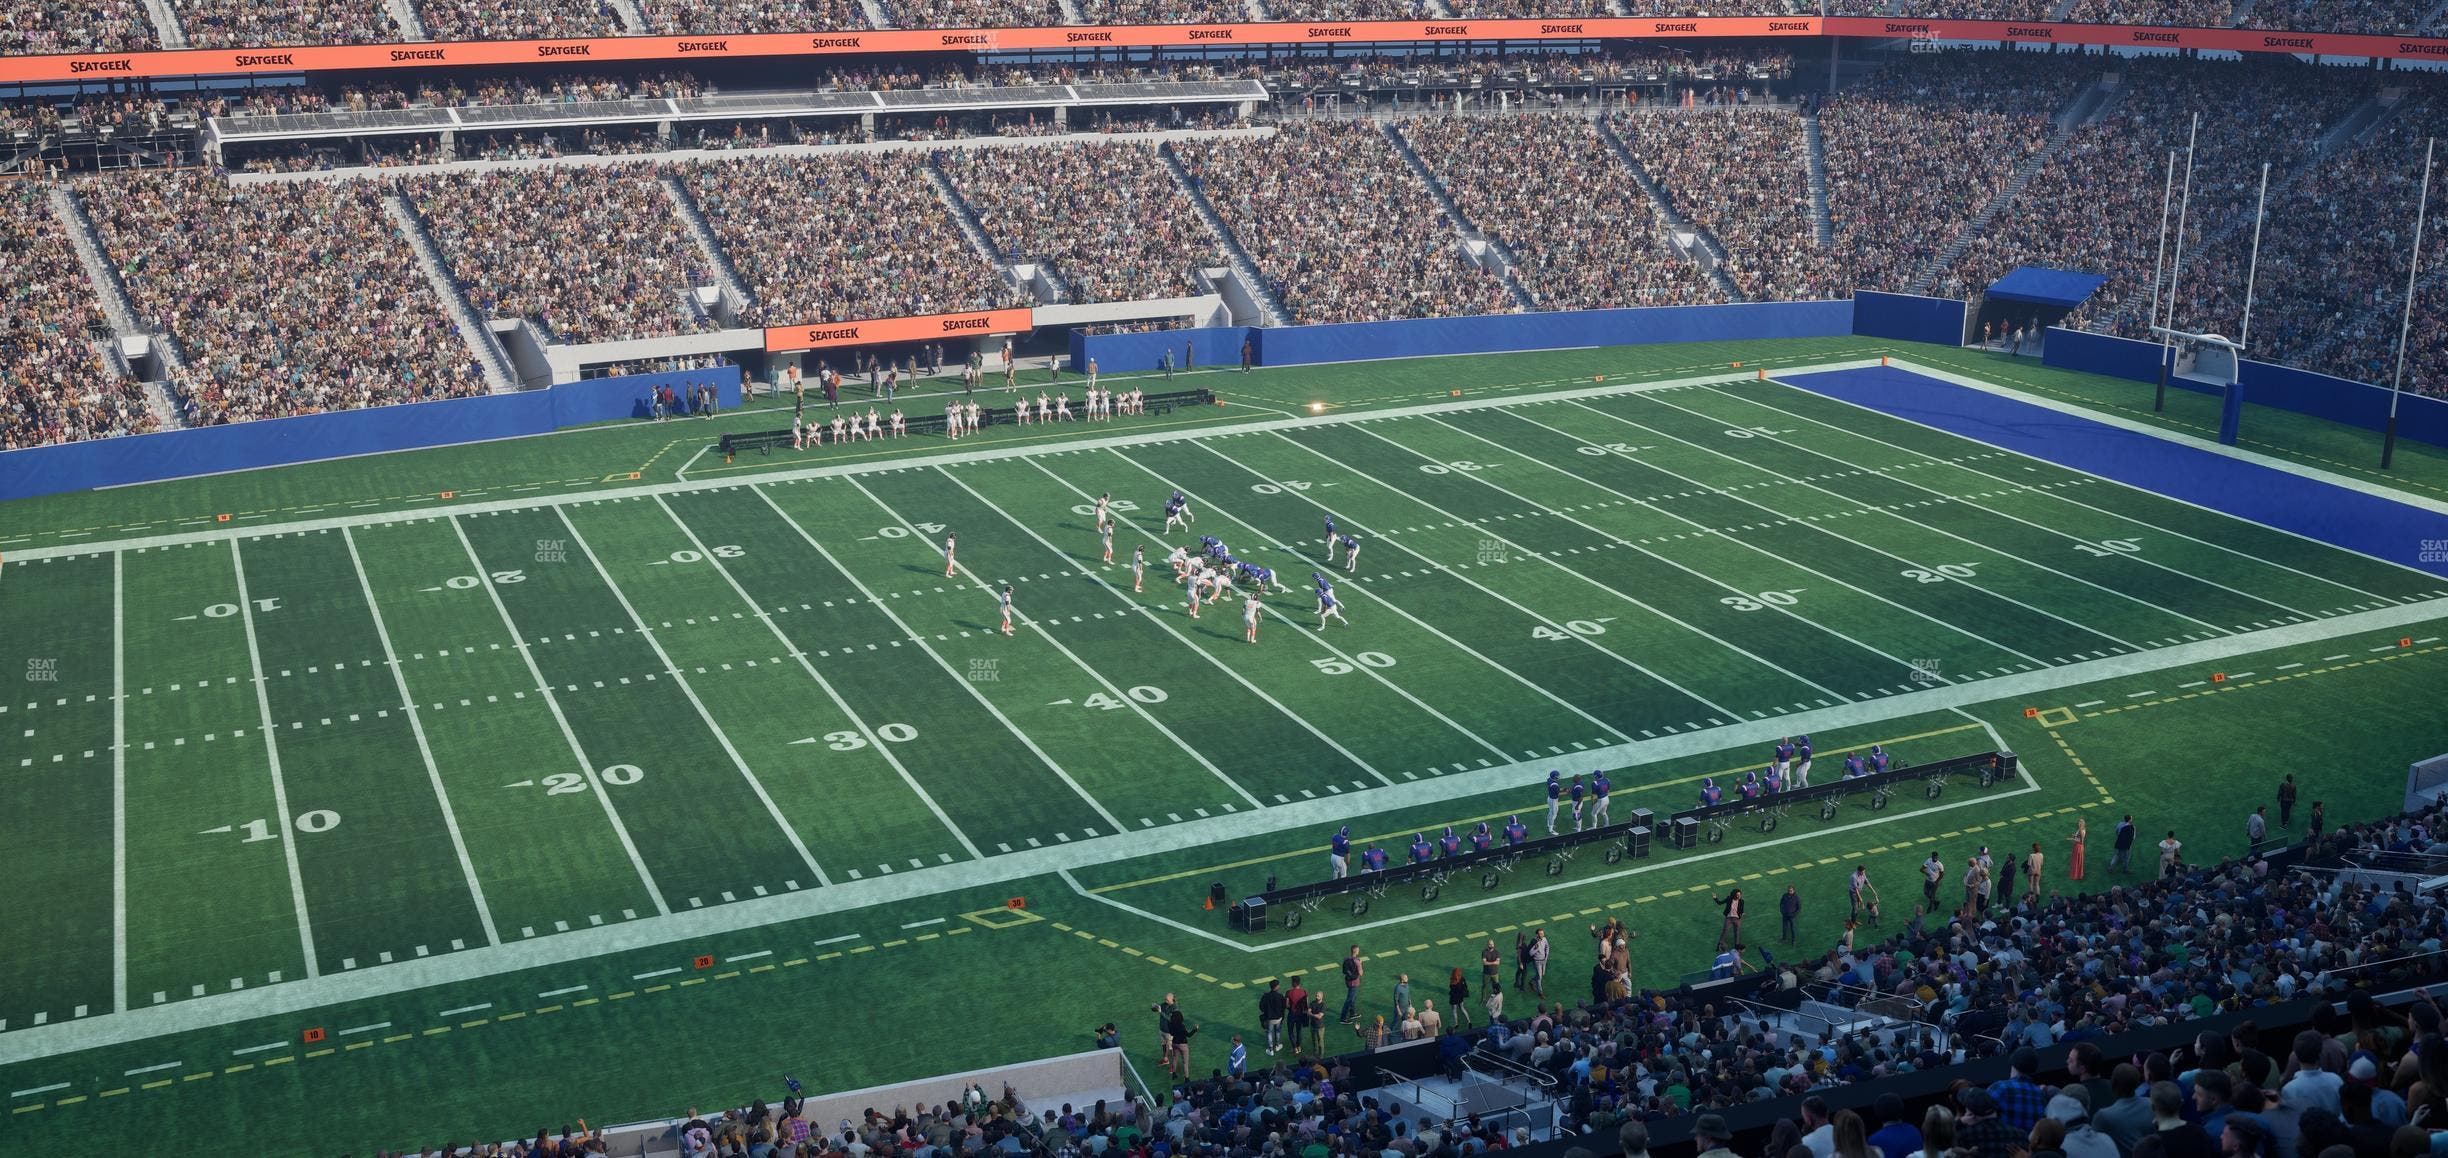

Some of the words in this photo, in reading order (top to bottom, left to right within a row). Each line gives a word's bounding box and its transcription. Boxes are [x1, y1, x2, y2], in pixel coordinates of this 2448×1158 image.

[1309, 28, 1351, 38] SEATGEEK
[1425, 26, 1467, 36] SEATGEEK
[1541, 25, 1582, 34] SEATGEEK
[1656, 23, 1697, 32] SEATGEEK
[1768, 22, 1808, 32] SEATGEEK
[2007, 27, 2052, 38] SEATGEEK
[942, 35, 988, 46] SEATGEEK
[1067, 32, 1112, 42] SEATGEEK
[1189, 30, 1232, 40] SEATGEEK
[2133, 32, 2180, 43] SEATGEEK
[678, 41, 728, 52] SEATGEEK
[813, 38, 860, 49] SEATGEEK
[2264, 36, 2314, 48] SEATGEEK
[391, 49, 445, 62] SEATGEEK
[538, 44, 590, 57] SEATGEEK
[71, 60, 132, 72] SEATGEEK
[236, 54, 294, 66] SEATGEEK
[942, 317, 990, 331] SEATGEEK
[810, 328, 859, 342] SEATGEEK
[2074, 540, 2142, 556] 10
[1901, 564, 1976, 584] 20
[1720, 592, 1798, 612] 30
[1532, 620, 1606, 640] 40
[1310, 652, 1396, 674] 50
[1084, 686, 1168, 710] 40
[824, 724, 918, 750] 30
[542, 767, 644, 796] 20
[240, 810, 340, 842] 10
